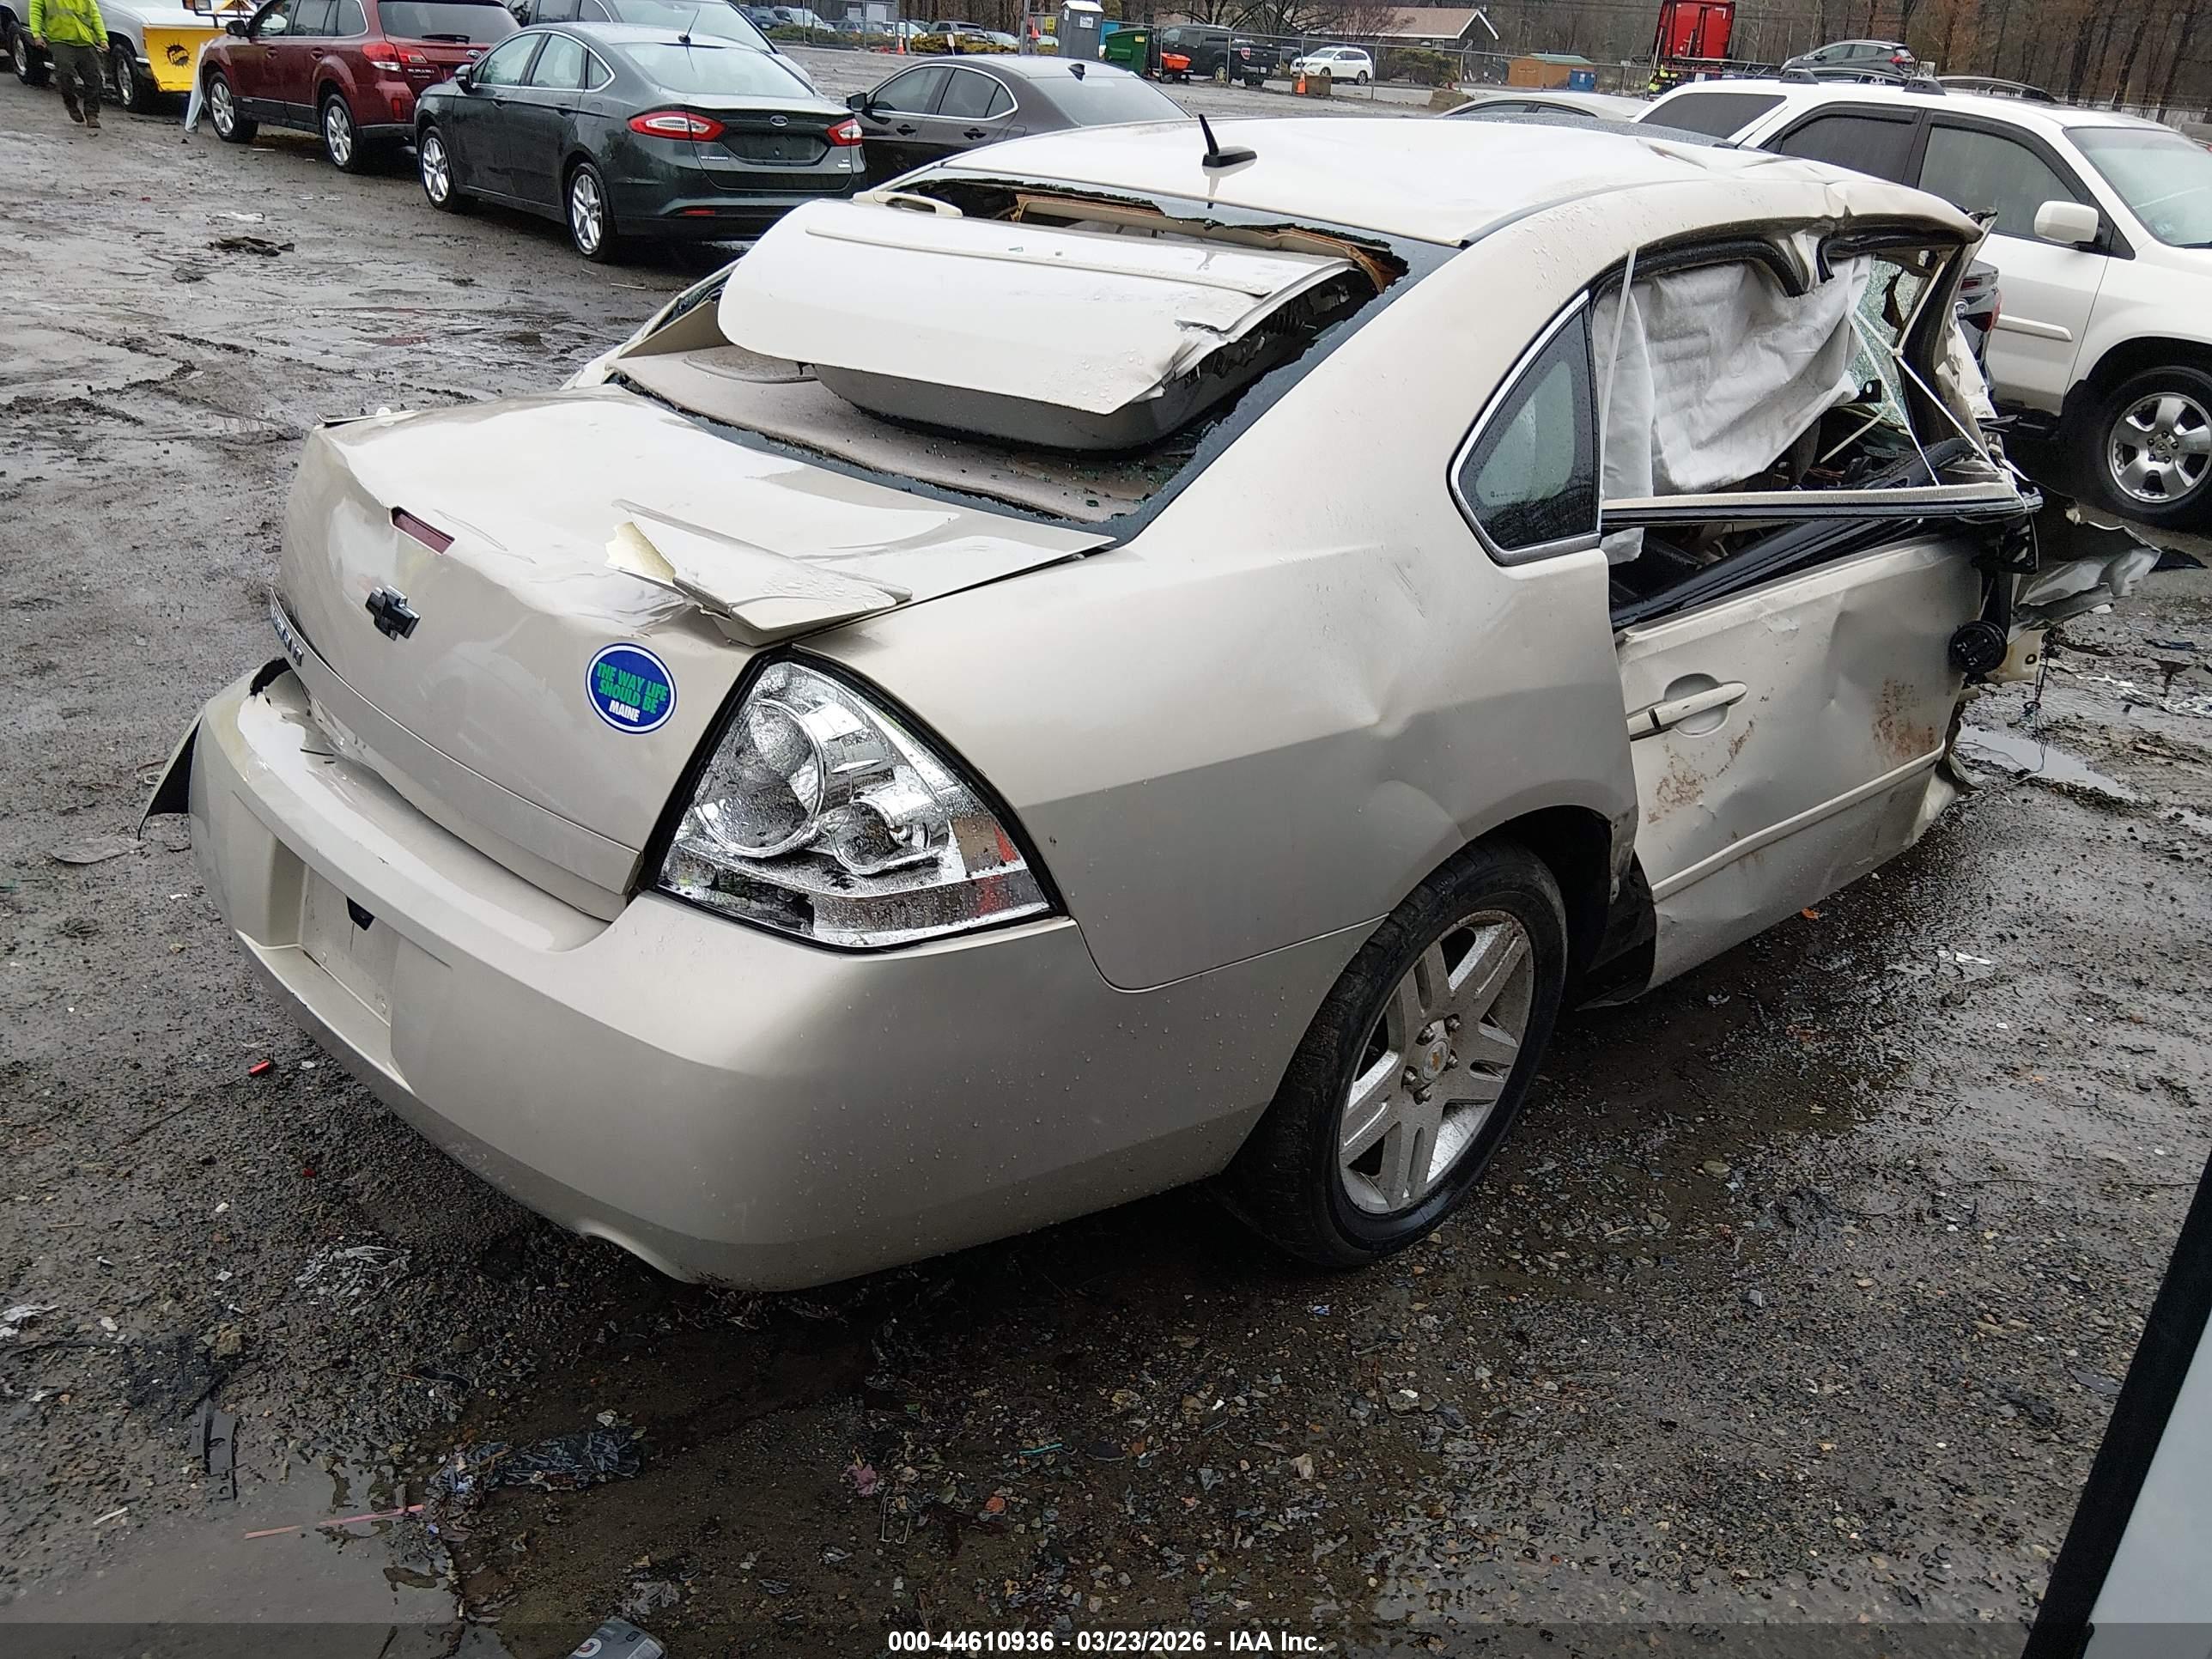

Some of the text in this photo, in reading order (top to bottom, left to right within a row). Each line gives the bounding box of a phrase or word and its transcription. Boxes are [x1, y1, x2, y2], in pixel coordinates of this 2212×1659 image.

[597, 661, 669, 702] THE WAY LIFE
[599, 679, 659, 714] SHOULD BE
[608, 699, 641, 723] MAINE
